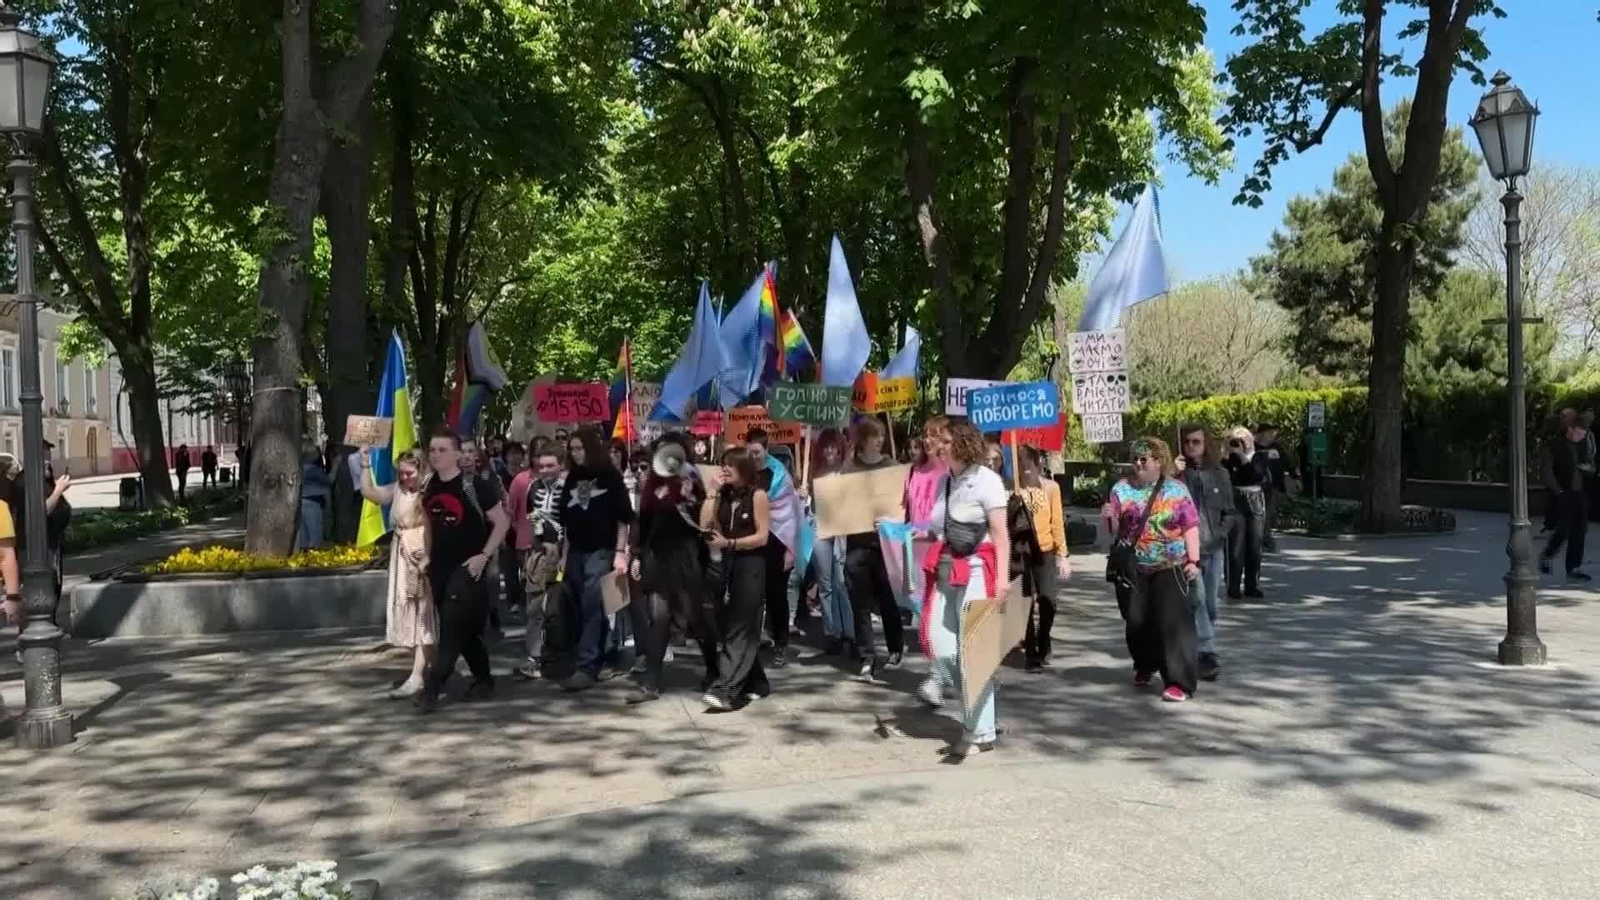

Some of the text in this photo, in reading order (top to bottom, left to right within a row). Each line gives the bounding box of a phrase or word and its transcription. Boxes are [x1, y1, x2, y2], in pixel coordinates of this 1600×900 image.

[1086, 333, 1105, 344] МИ
[1080, 398, 1126, 413] ЧИТАТИ
[972, 401, 1054, 425] ПОБОРЕМО
[1084, 414, 1120, 427] ПРОТИ
